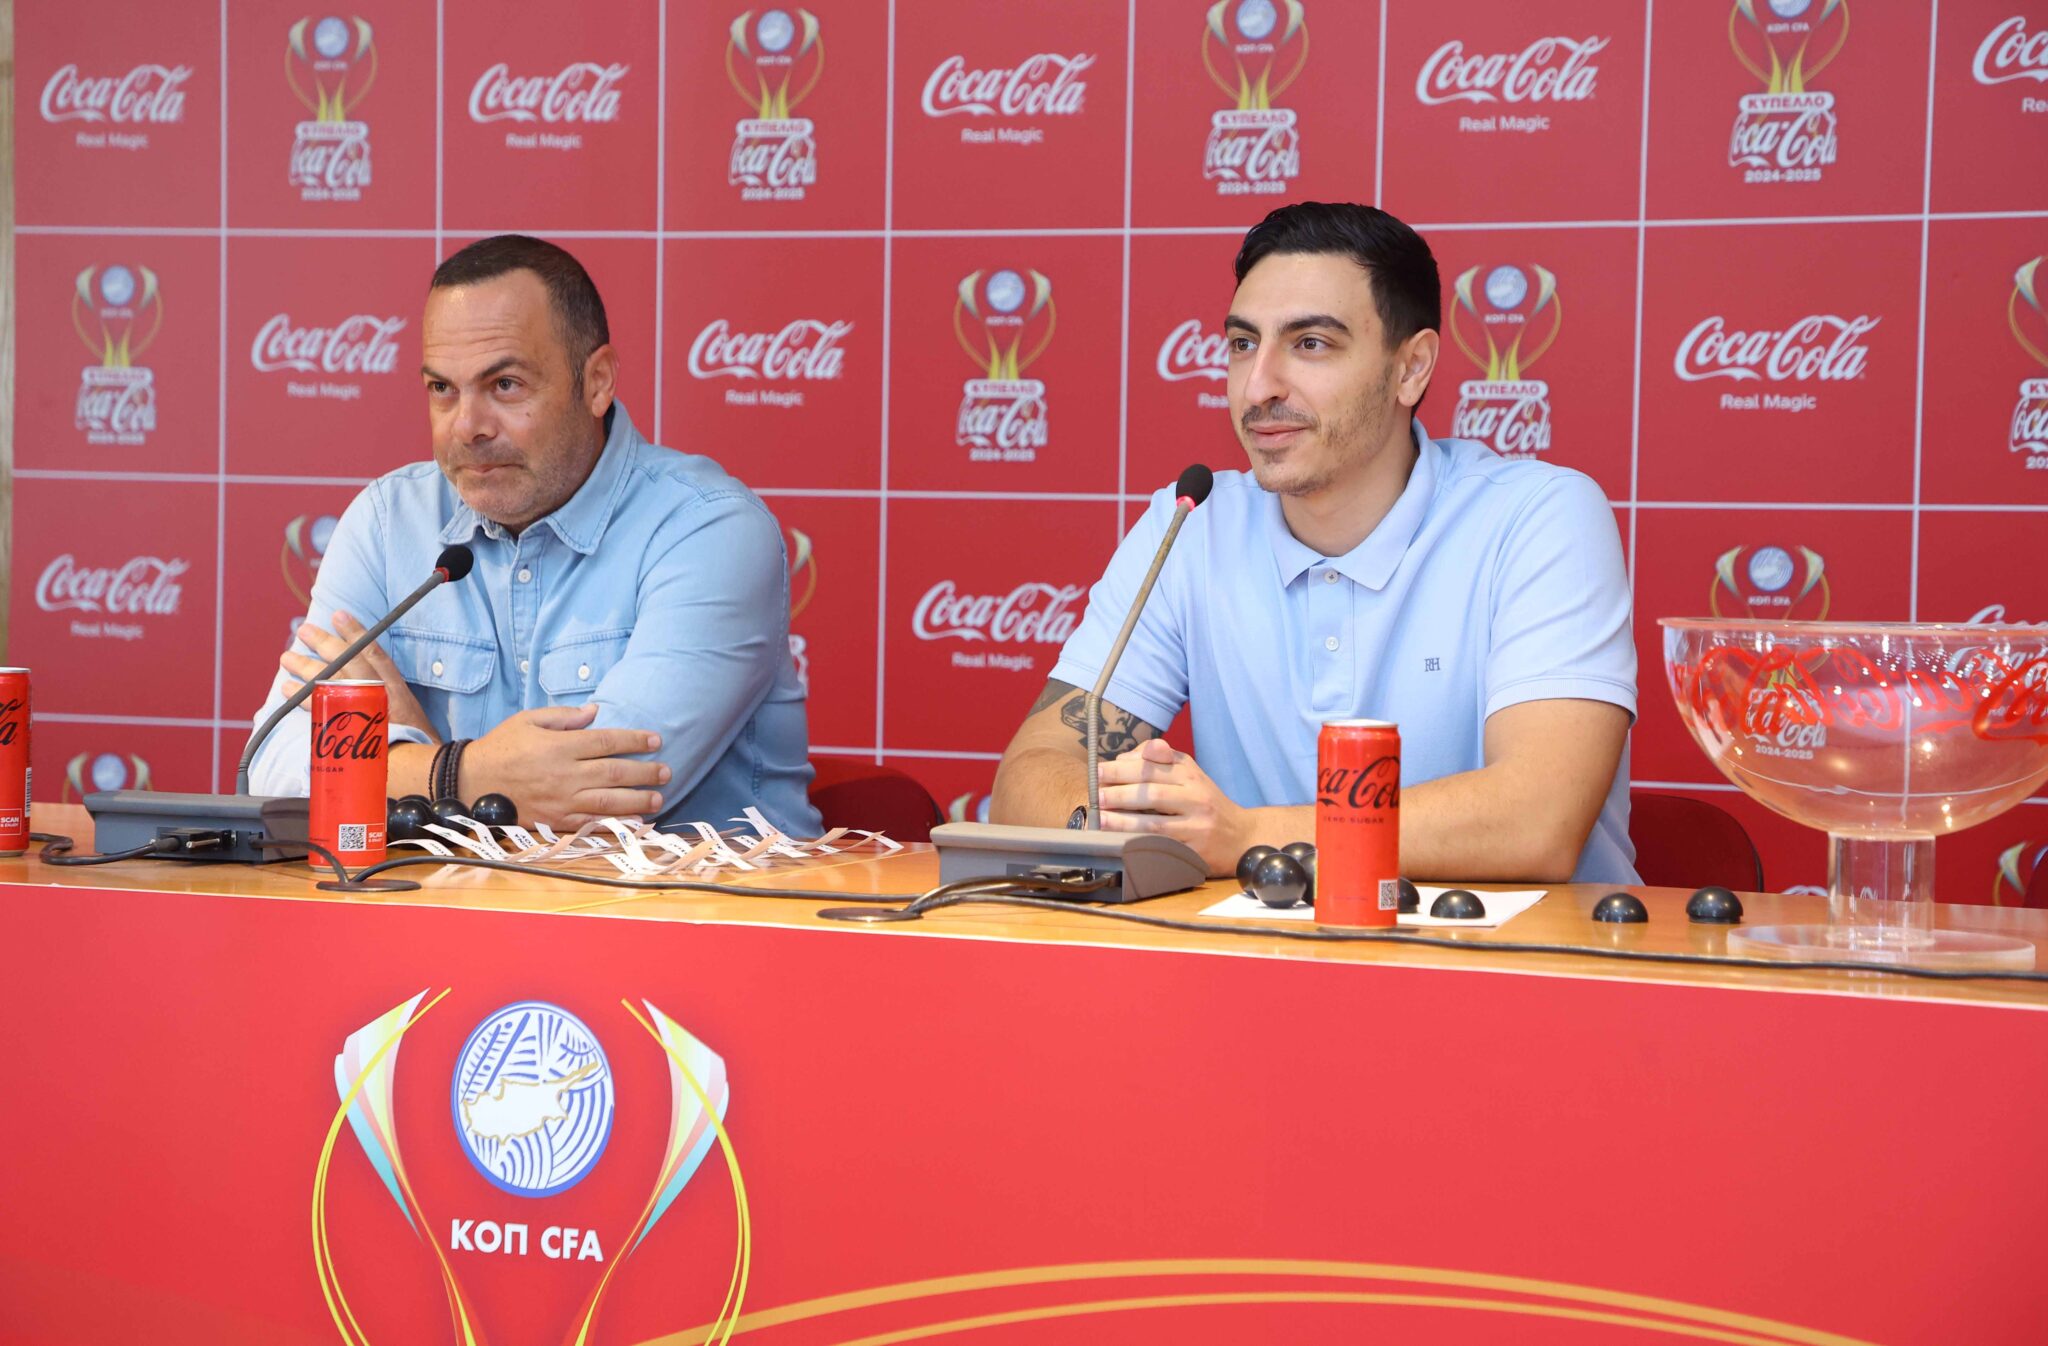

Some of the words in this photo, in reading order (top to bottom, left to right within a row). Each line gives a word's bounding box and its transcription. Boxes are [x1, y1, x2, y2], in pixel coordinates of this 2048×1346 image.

[1459, 117, 1497, 132] Real
[1500, 115, 1549, 134] Magic
[76, 133, 106, 147] Real
[108, 133, 148, 151] Magic
[506, 134, 538, 148] Real
[540, 134, 582, 150] Magic
[961, 128, 995, 143] Real
[997, 127, 1043, 145] Magic
[1744, 168, 1822, 183] 2024-2025
[287, 382, 318, 397] Real
[320, 382, 361, 400] Magic
[726, 390, 758, 405] Real
[760, 390, 804, 408] Magic
[1720, 394, 1760, 410] Real
[1763, 394, 1816, 412] Magic
[71, 621, 101, 637] Real
[103, 622, 144, 640] Magic
[952, 652, 986, 668] Real
[988, 652, 1033, 671] Magic
[451, 1218, 529, 1256] ΚΟΠ
[541, 1225, 604, 1262] CFA
